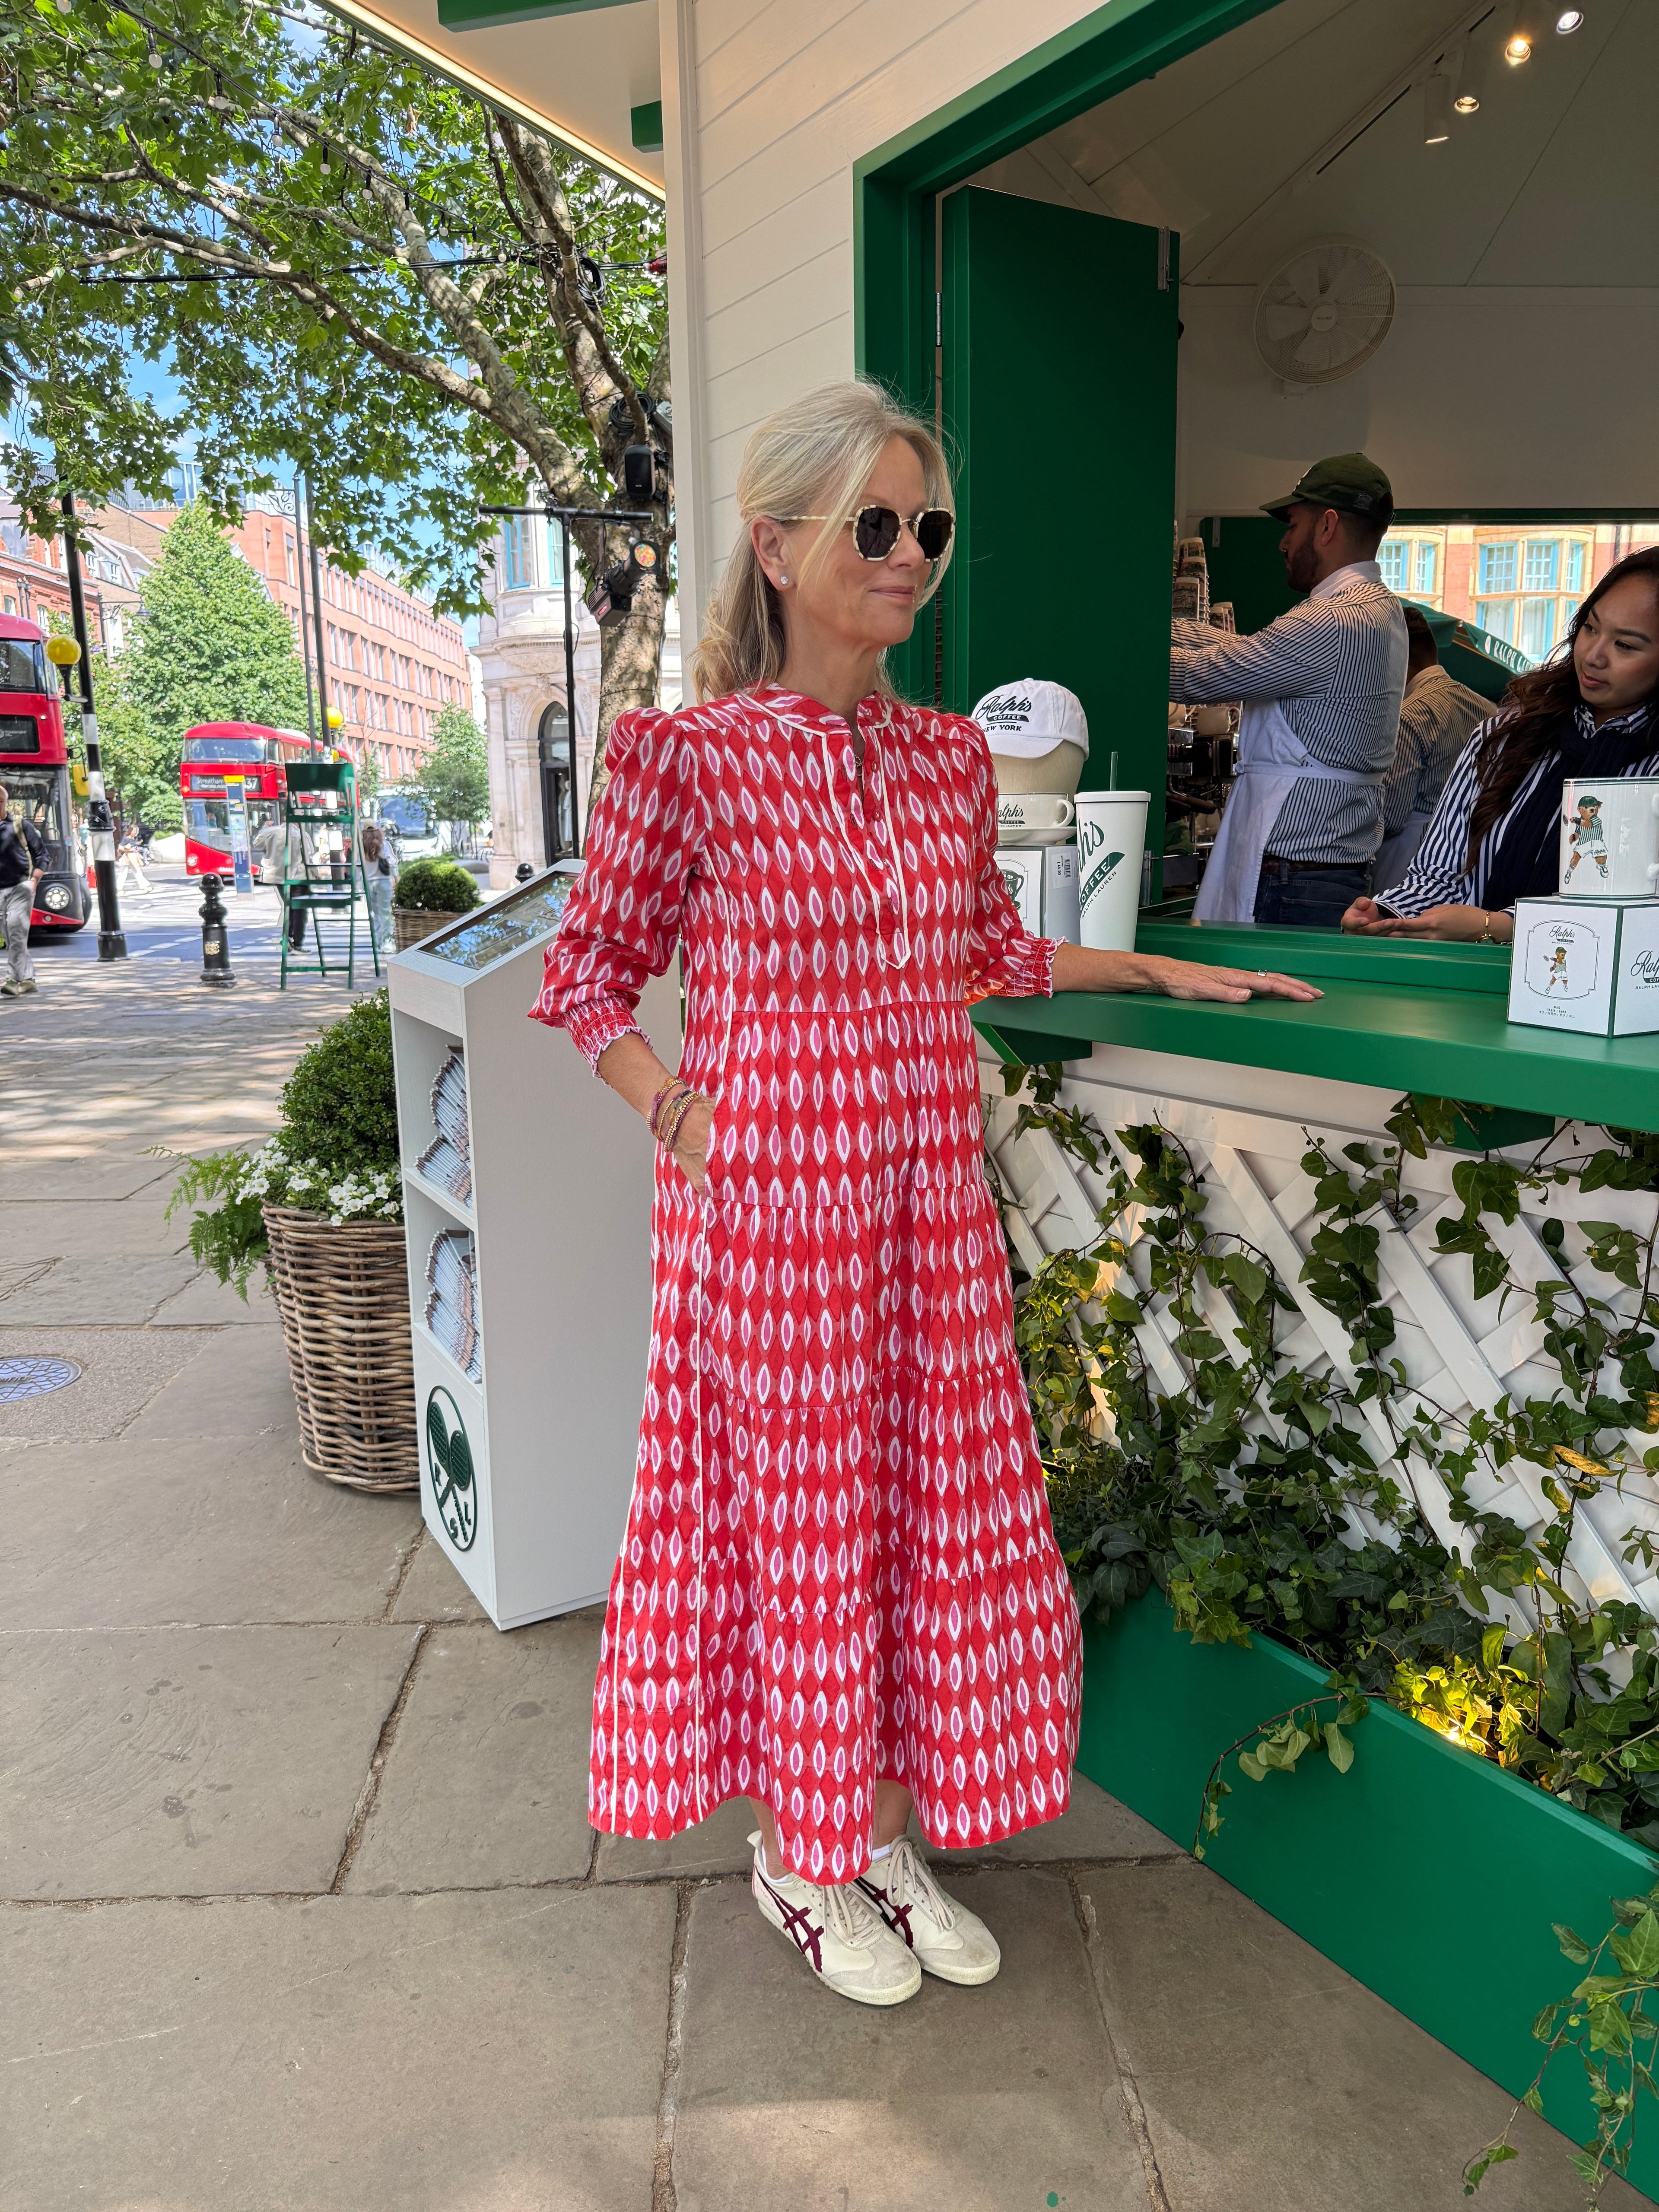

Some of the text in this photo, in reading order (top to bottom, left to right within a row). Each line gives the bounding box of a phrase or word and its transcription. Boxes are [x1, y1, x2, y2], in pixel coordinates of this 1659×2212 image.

[1494, 641, 1517, 668] RALPH
[976, 695, 1032, 720] Ralph's
[998, 803, 1023, 820] alph's
[1080, 862, 1111, 911] COFFEE
[1082, 871, 1117, 919] RALPH LAUREN
[1549, 925, 1575, 940] Ralph's
